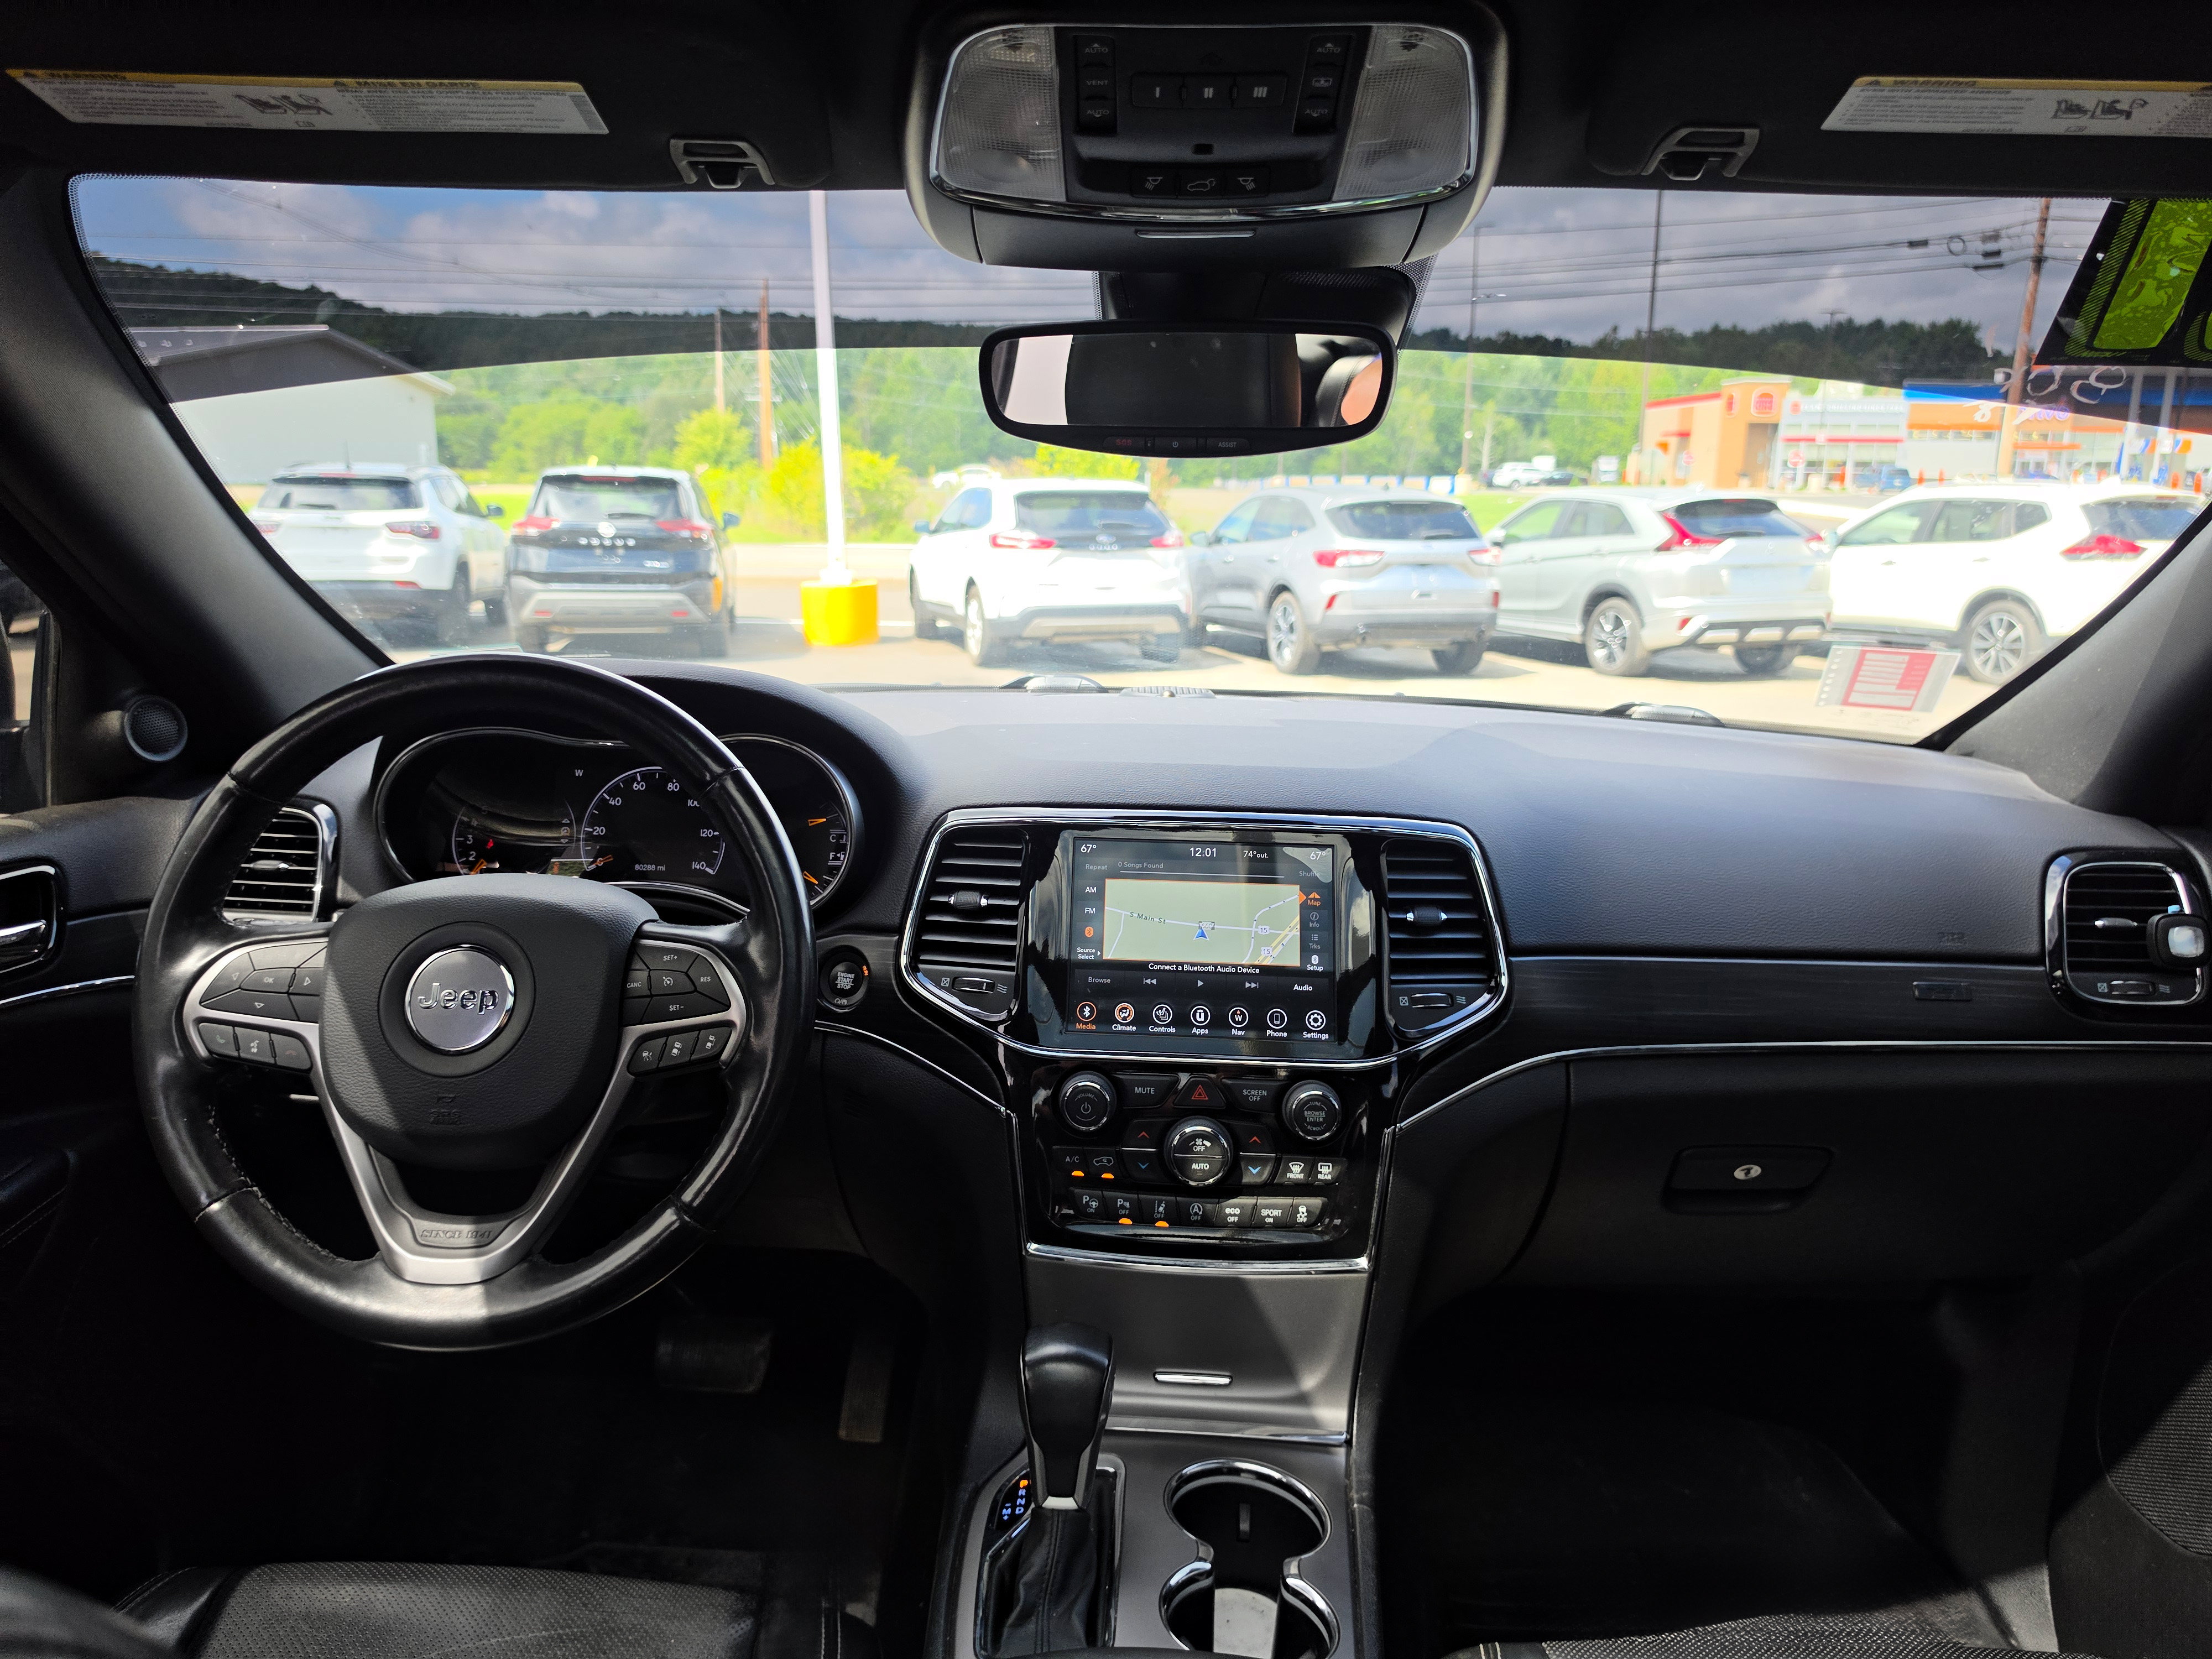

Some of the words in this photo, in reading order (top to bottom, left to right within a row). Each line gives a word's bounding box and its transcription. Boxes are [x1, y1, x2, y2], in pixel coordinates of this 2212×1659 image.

[633, 781, 646, 790] 60
[667, 782, 680, 791] 80
[609, 797, 622, 806] 40
[593, 826, 606, 836] 20
[700, 829, 713, 837] 120
[466, 835, 473, 844] 3
[830, 834, 836, 842] C
[1081, 844, 1097, 853] 67°
[1190, 847, 1217, 857] 12:01
[469, 852, 476, 860] 2
[830, 852, 836, 860] F
[692, 861, 706, 870] 140
[1137, 913, 1155, 922] Main
[1149, 963, 1177, 971] Connect
[1183, 964, 1215, 972] Bluetooth
[1217, 965, 1236, 973] Audio
[418, 982, 499, 1015] Jeep
[1191, 1027, 1209, 1035] Apps
[1302, 1031, 1329, 1040] Settings
[421, 1229, 462, 1239] SINCE
[1019, 1479, 1028, 1488] P
